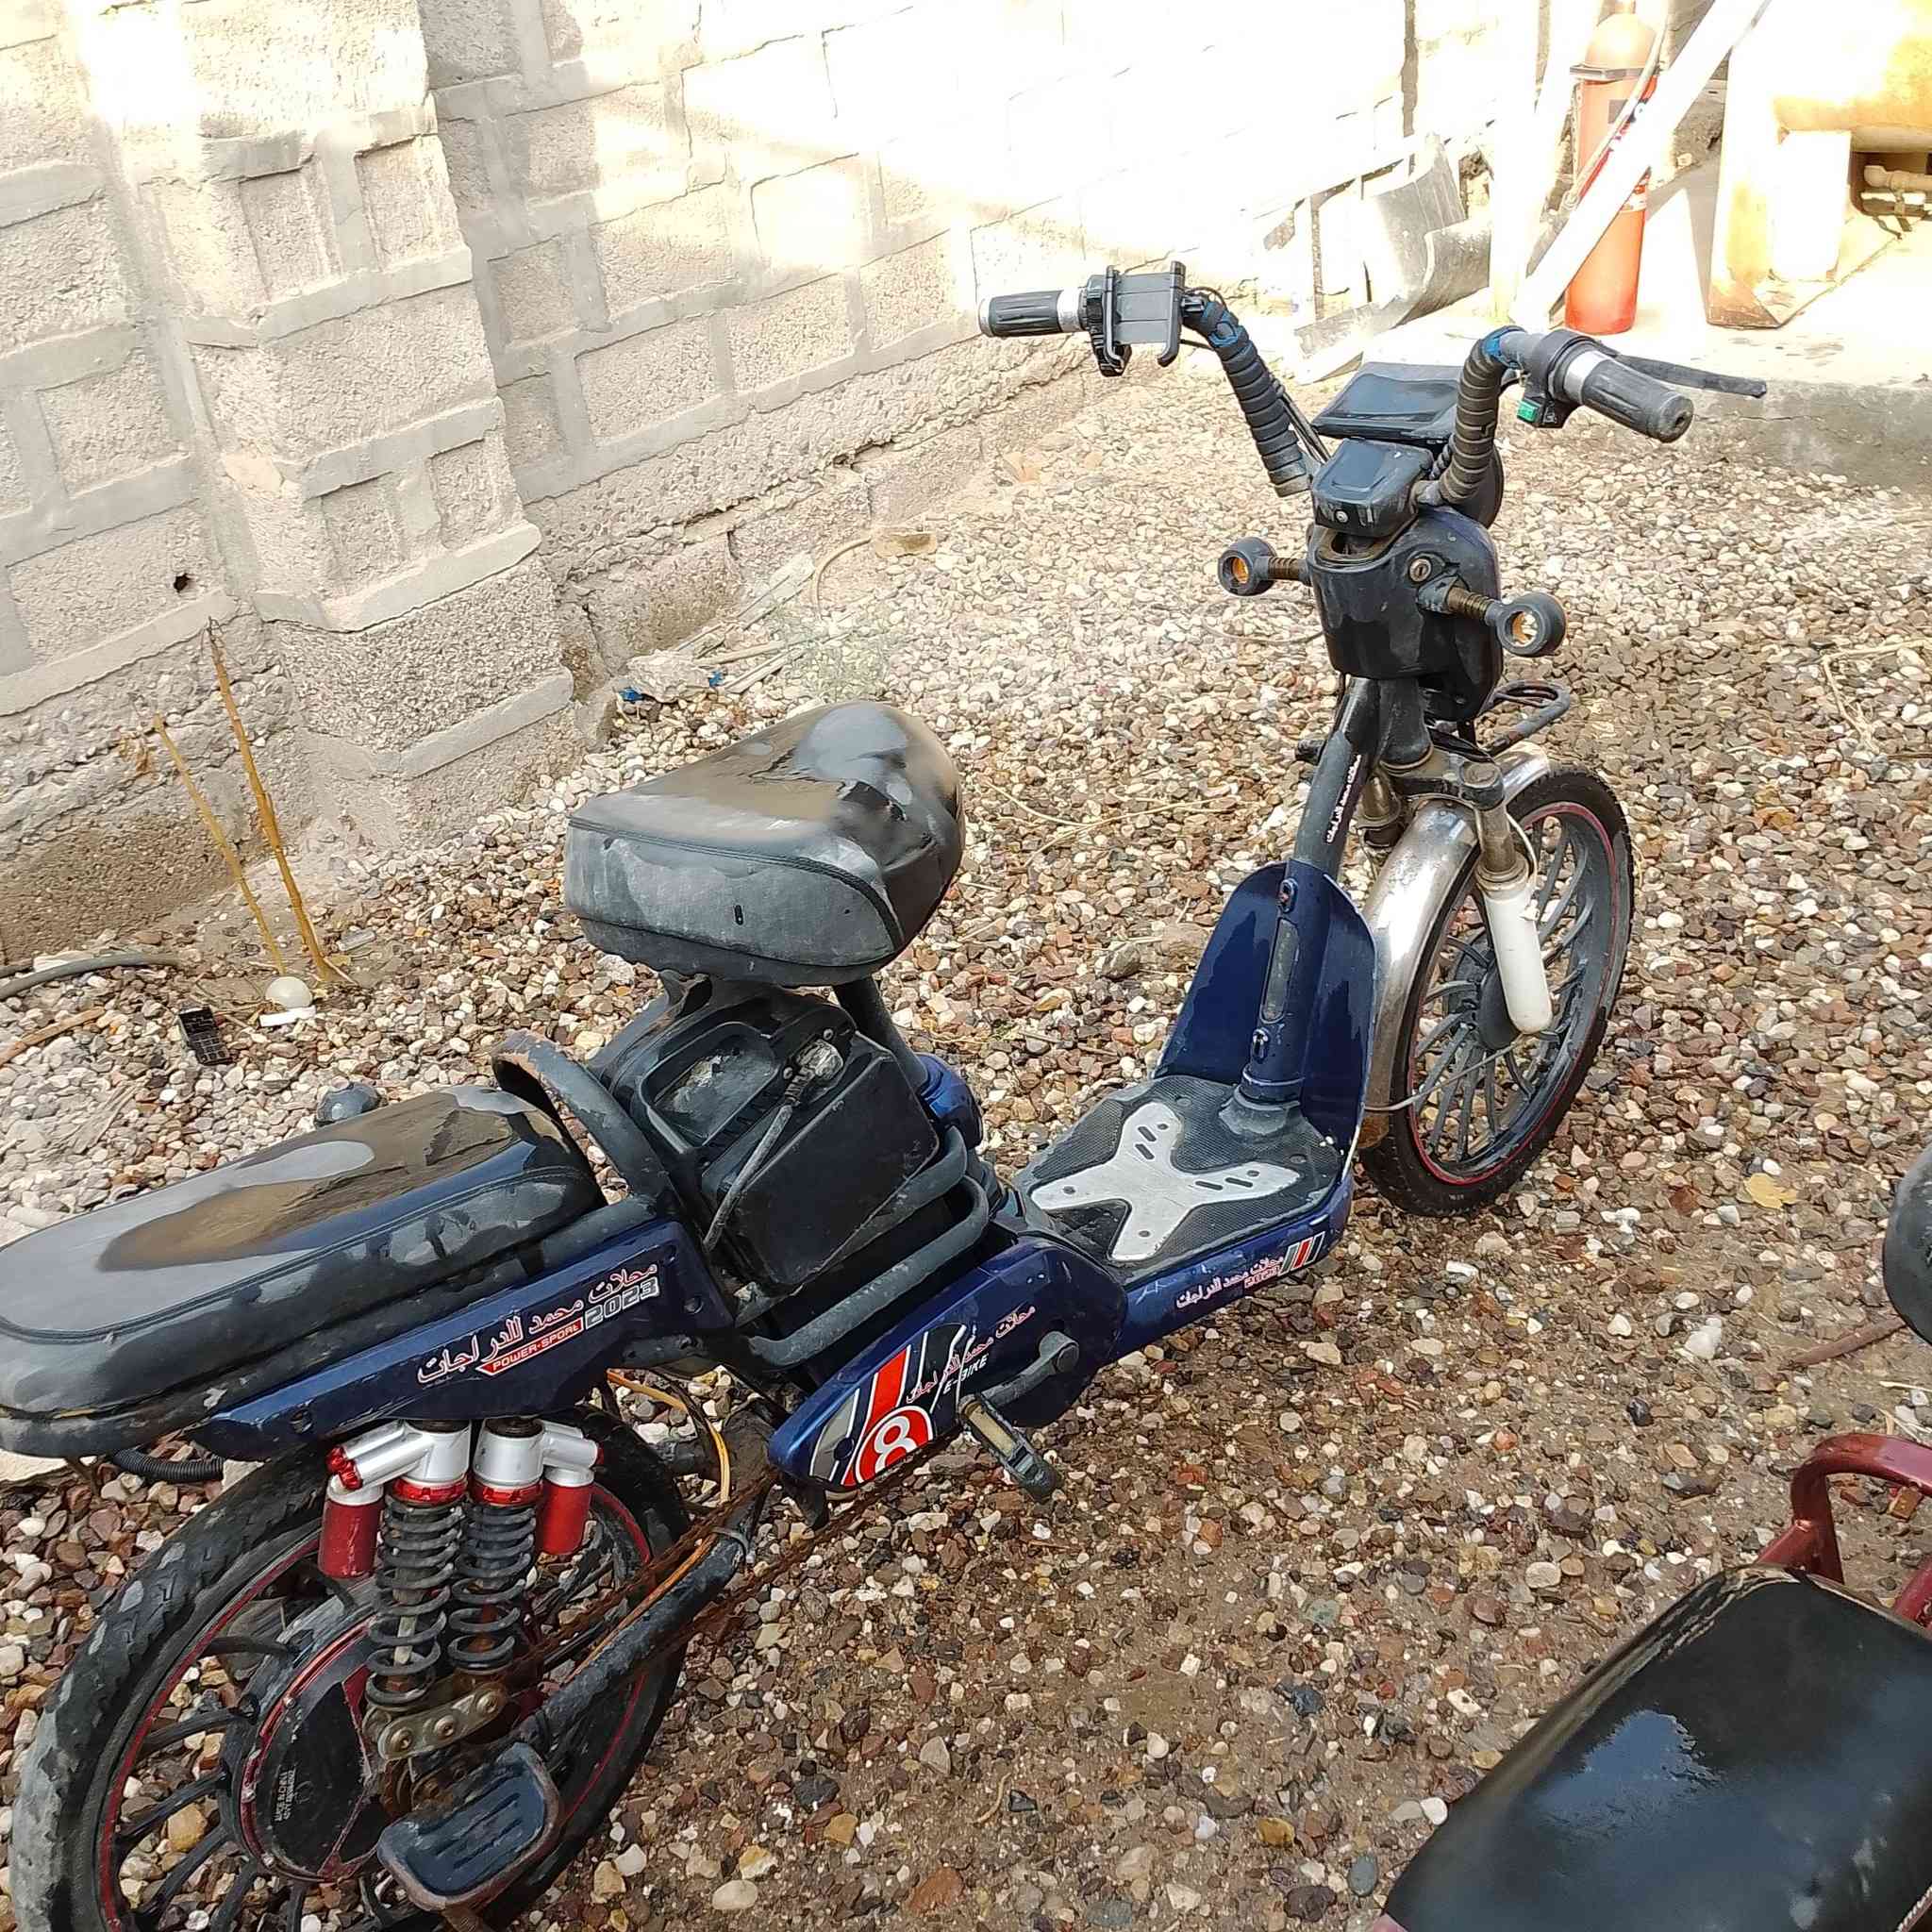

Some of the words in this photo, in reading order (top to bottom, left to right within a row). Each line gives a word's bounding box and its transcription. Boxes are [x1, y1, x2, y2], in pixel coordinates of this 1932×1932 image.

[1223, 1269, 1250, 1288] محمد
[1250, 1257, 1284, 1275] محلات
[588, 1263, 658, 1305] محلات
[528, 1298, 584, 1334] محمد
[585, 1276, 659, 1329] 2023
[995, 1306, 1037, 1339] محلات
[964, 1337, 994, 1363] محمد
[874, 1415, 919, 1474] 8
